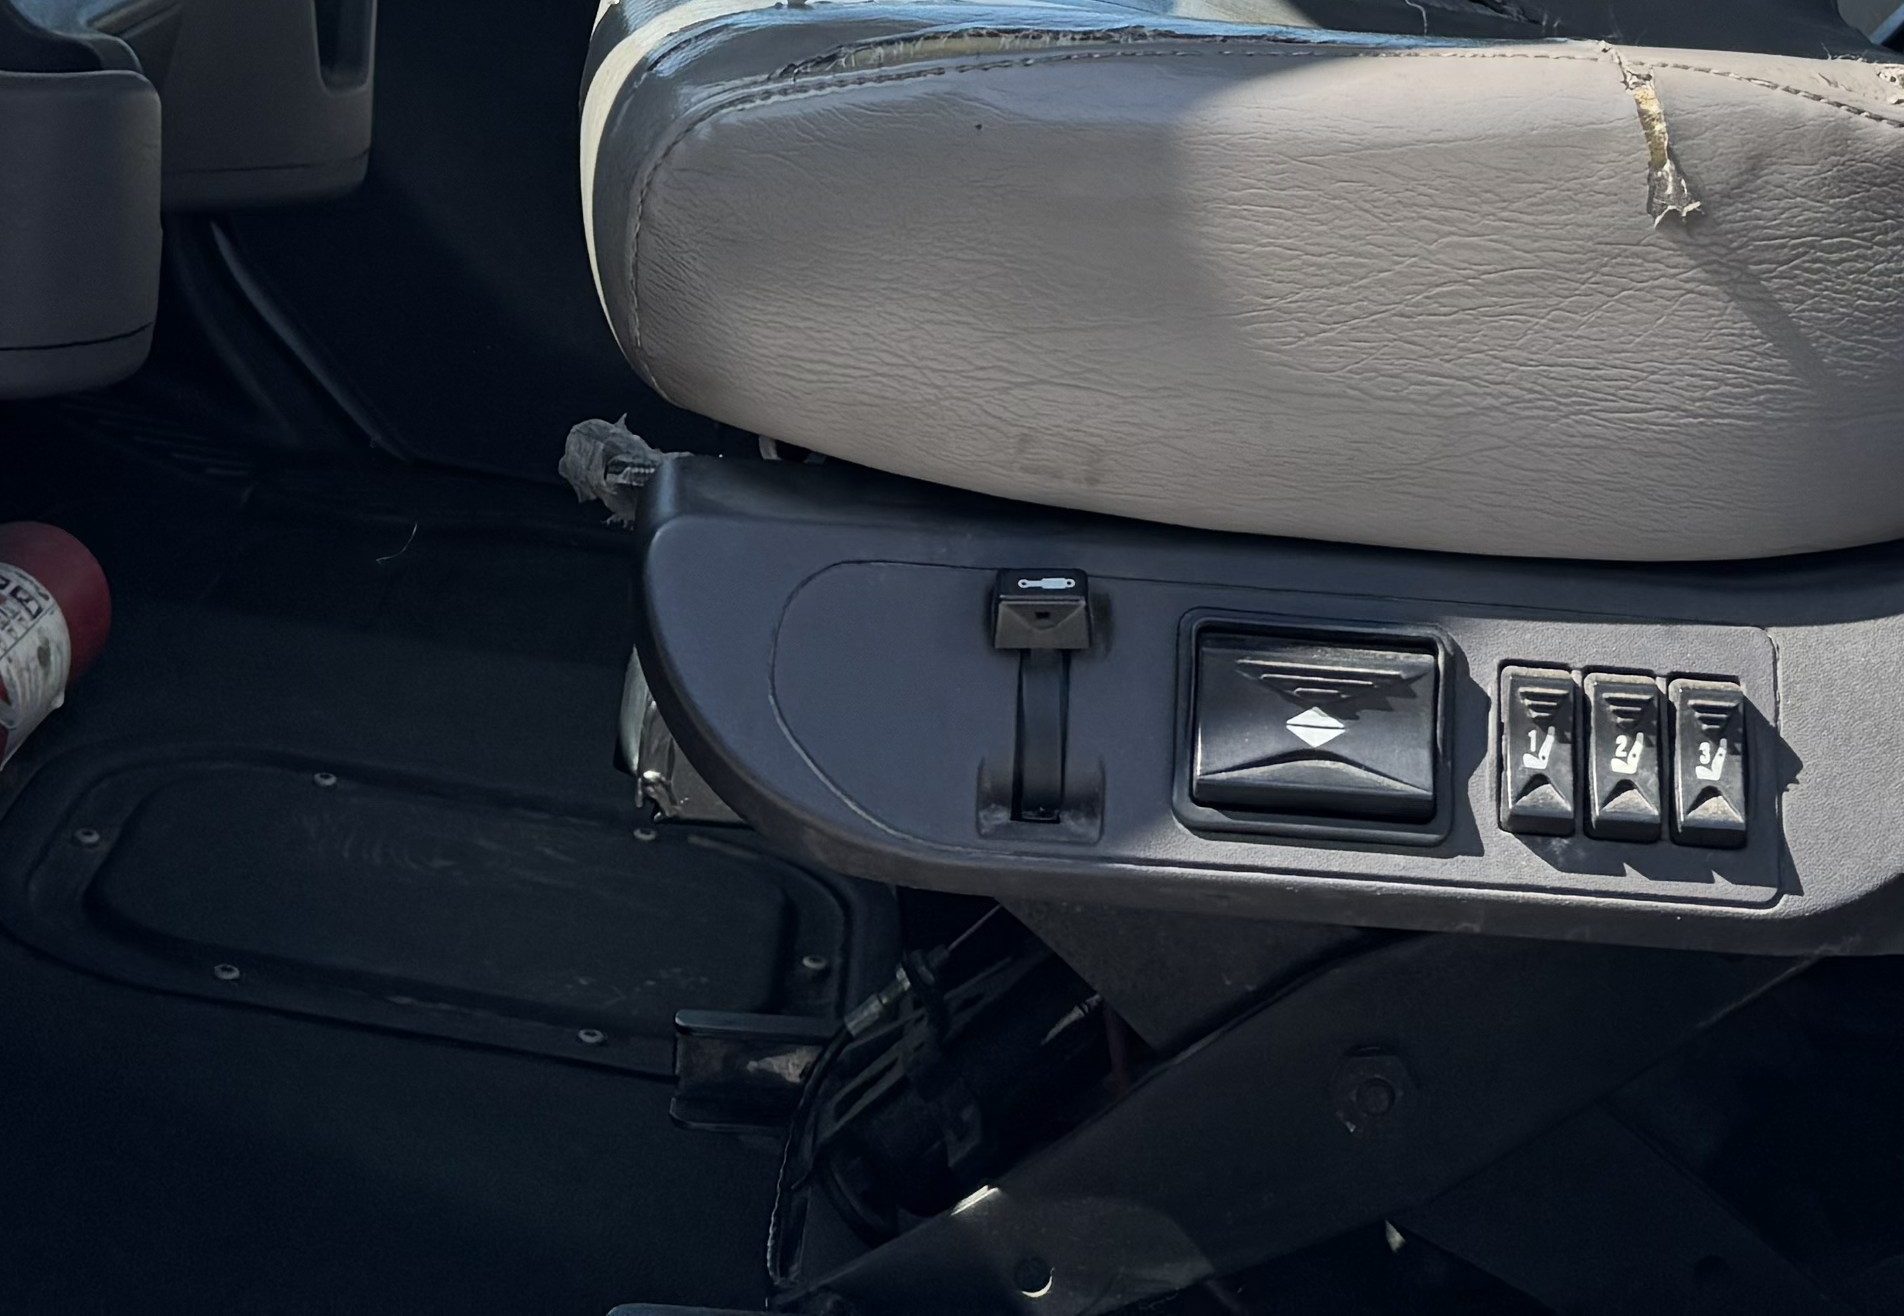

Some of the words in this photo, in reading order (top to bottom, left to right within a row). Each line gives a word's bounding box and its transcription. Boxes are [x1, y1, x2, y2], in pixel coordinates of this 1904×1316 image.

[1527, 729, 1537, 752] 1
[1615, 734, 1627, 757] 2
[1699, 741, 1711, 765] 3
